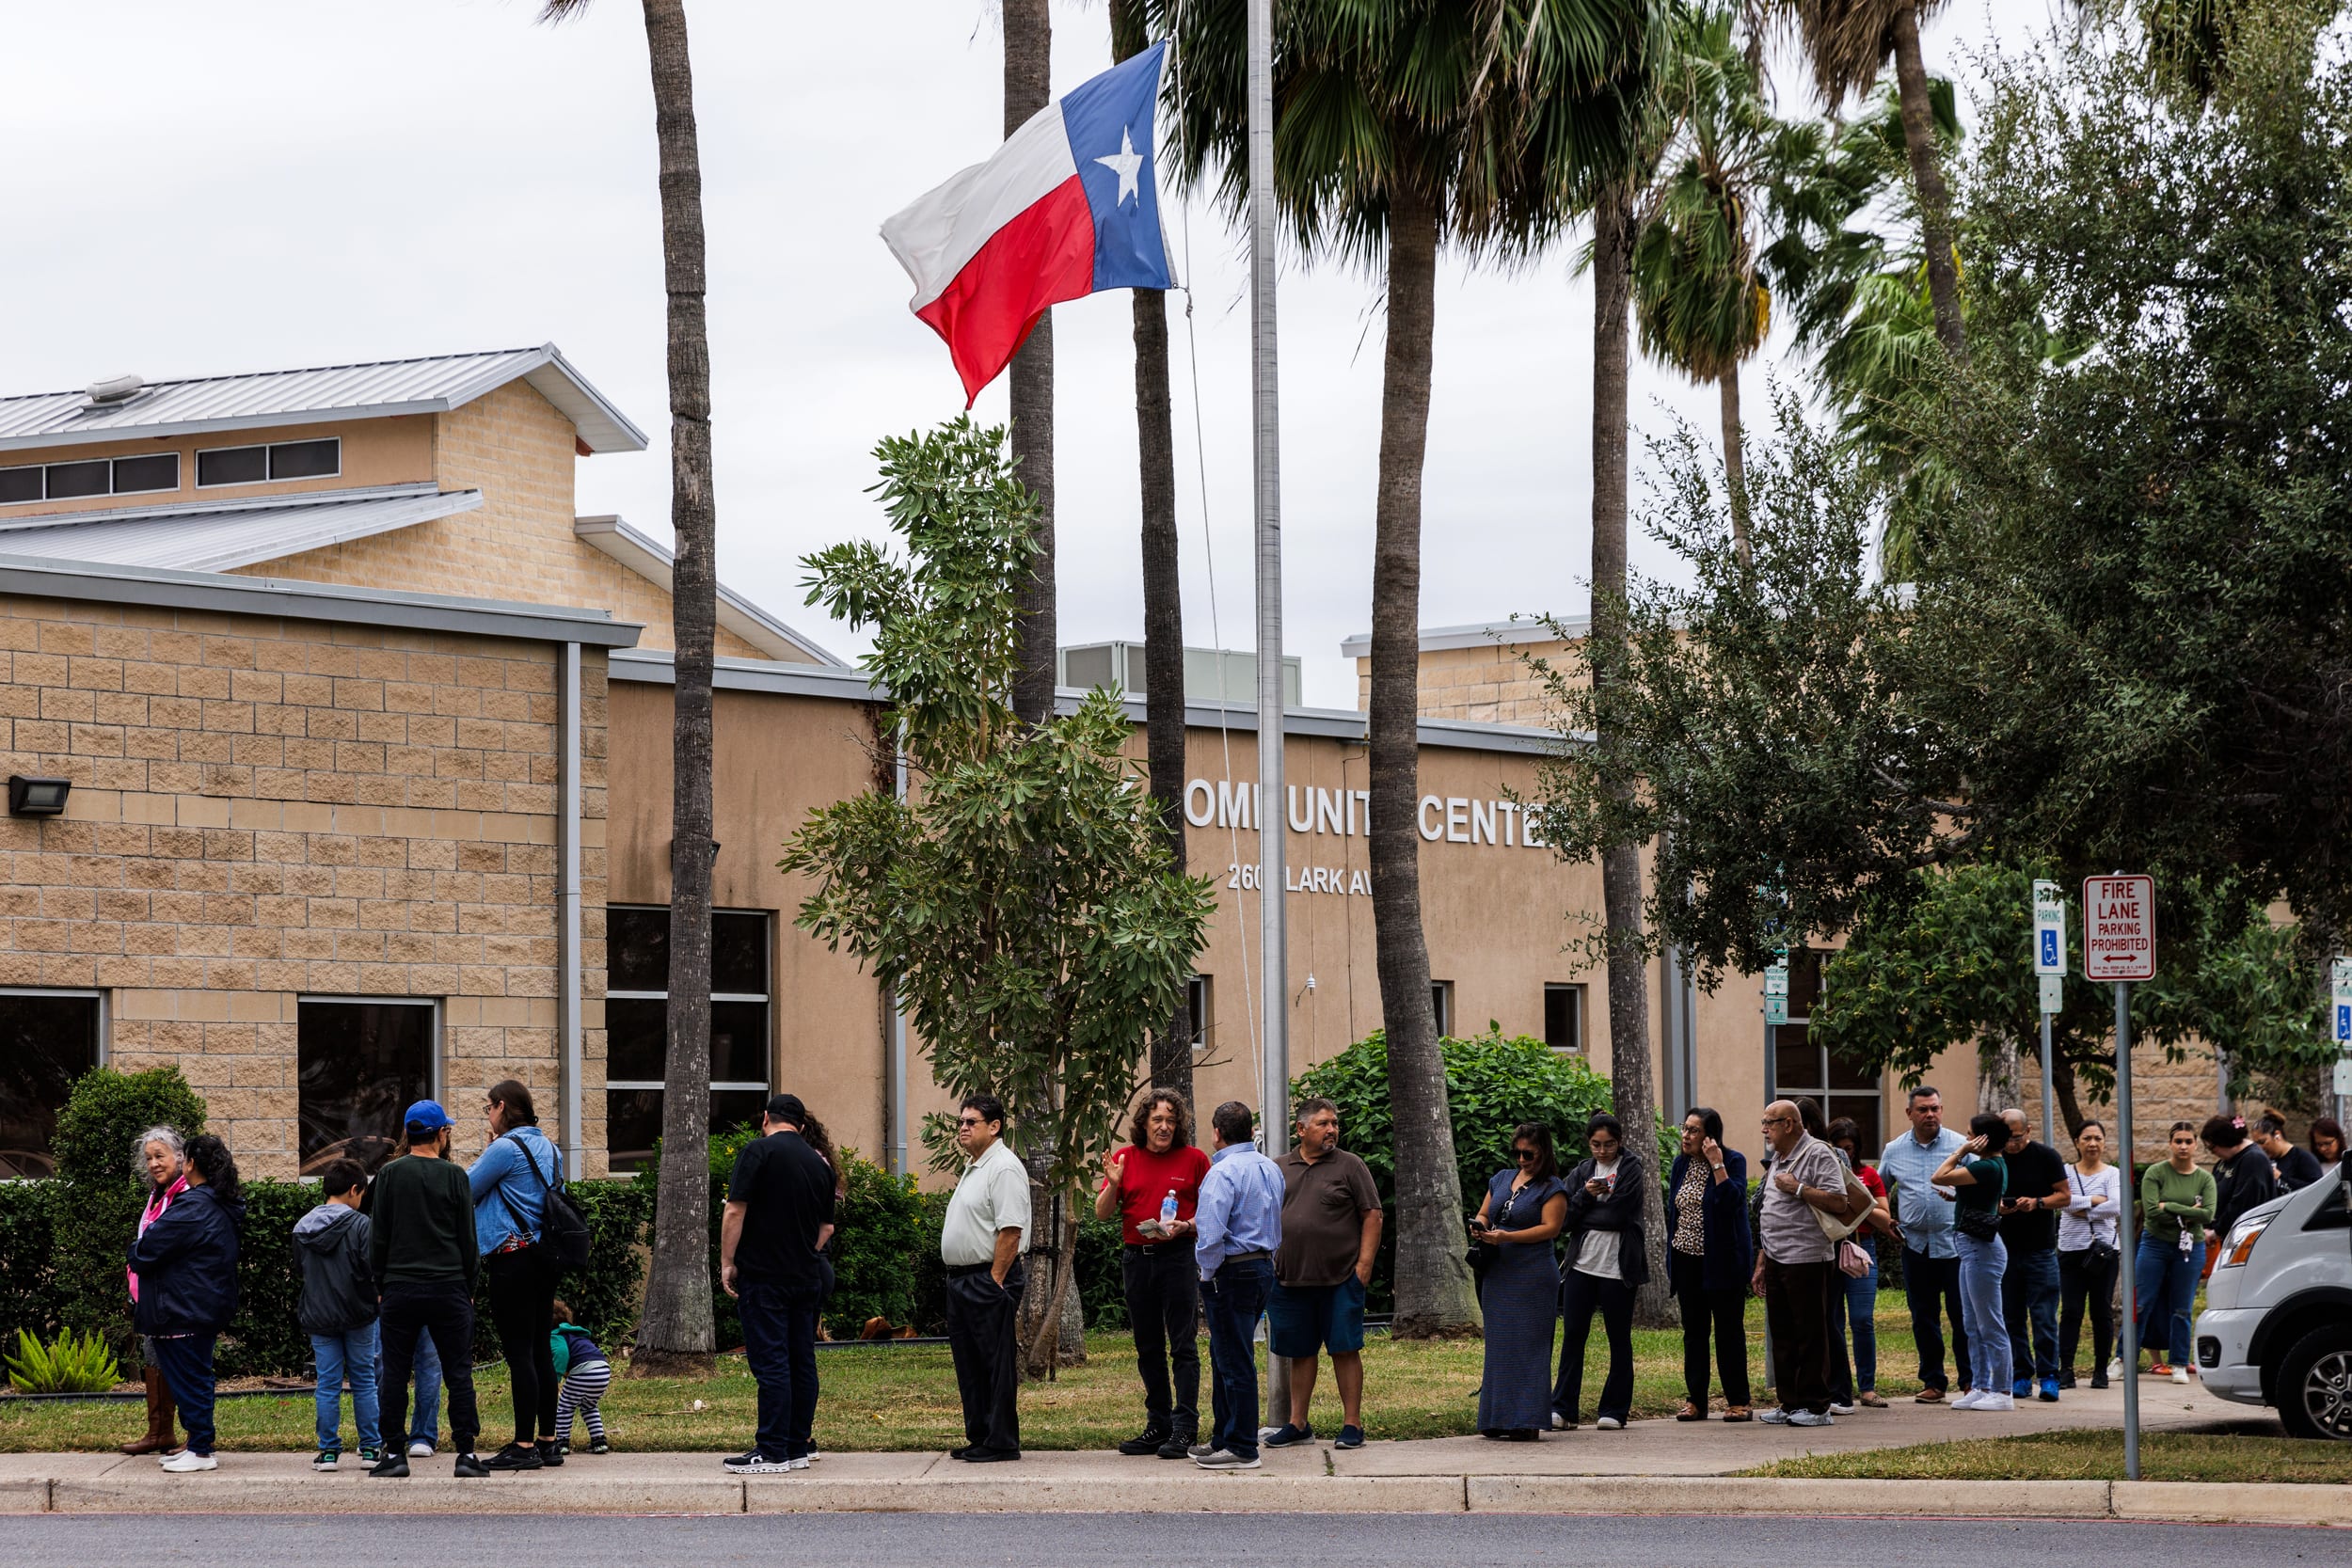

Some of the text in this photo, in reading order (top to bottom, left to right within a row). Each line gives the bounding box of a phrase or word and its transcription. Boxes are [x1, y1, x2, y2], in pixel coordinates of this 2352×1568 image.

[1418, 795, 1558, 848] CENTE
[1285, 865, 1344, 895] LARK
[2102, 881, 2136, 899] FIRE
[2098, 902, 2140, 920] LANE
[2098, 922, 2140, 936] PARKING
[2091, 938, 2149, 952] PROHIBITED
